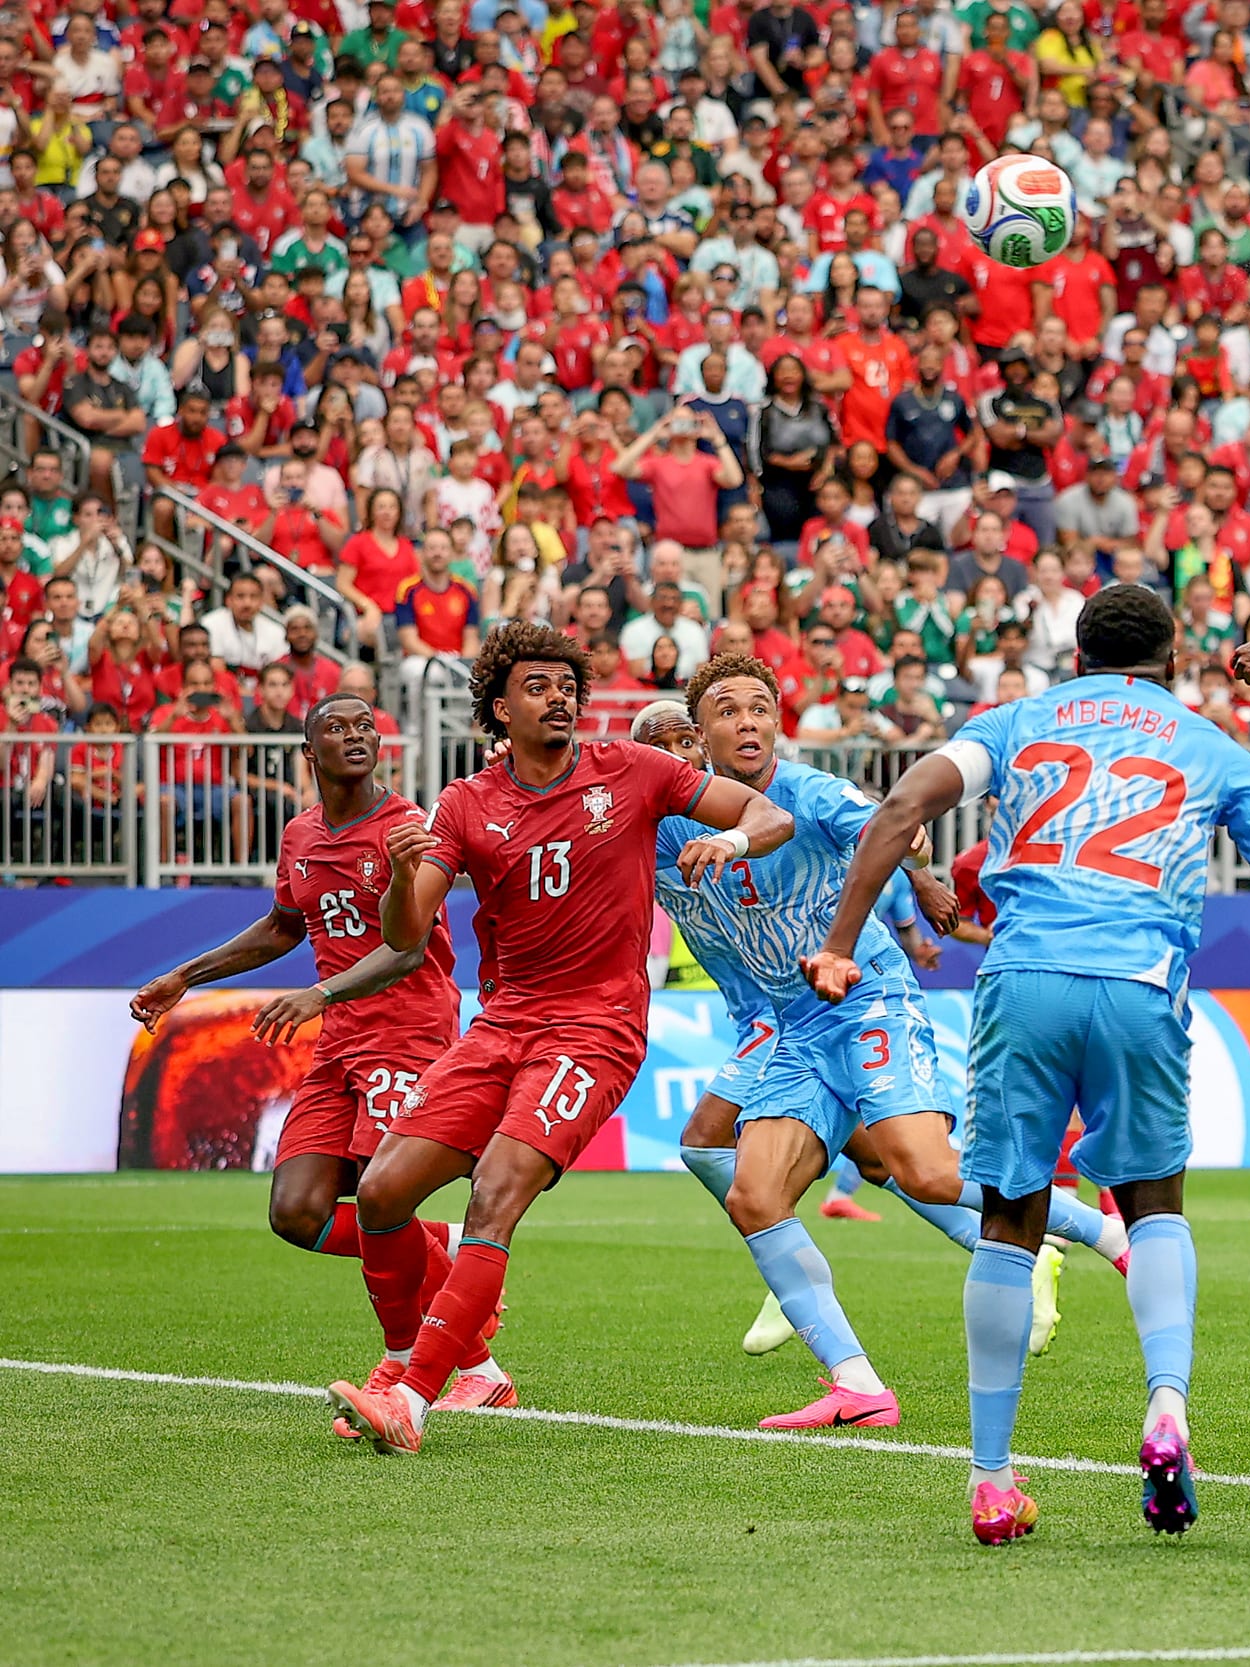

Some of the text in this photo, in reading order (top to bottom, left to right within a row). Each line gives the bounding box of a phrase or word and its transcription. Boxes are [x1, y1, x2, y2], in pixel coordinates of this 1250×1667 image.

[1056, 700, 1179, 745] MBEMBA
[1004, 740, 1188, 890] 22
[525, 839, 573, 901] 13
[730, 859, 760, 909] 3
[319, 888, 368, 938] 25
[735, 1020, 775, 1060] 7
[858, 1027, 892, 1071] 3
[365, 1066, 419, 1120] 25
[538, 1053, 597, 1122] 13
